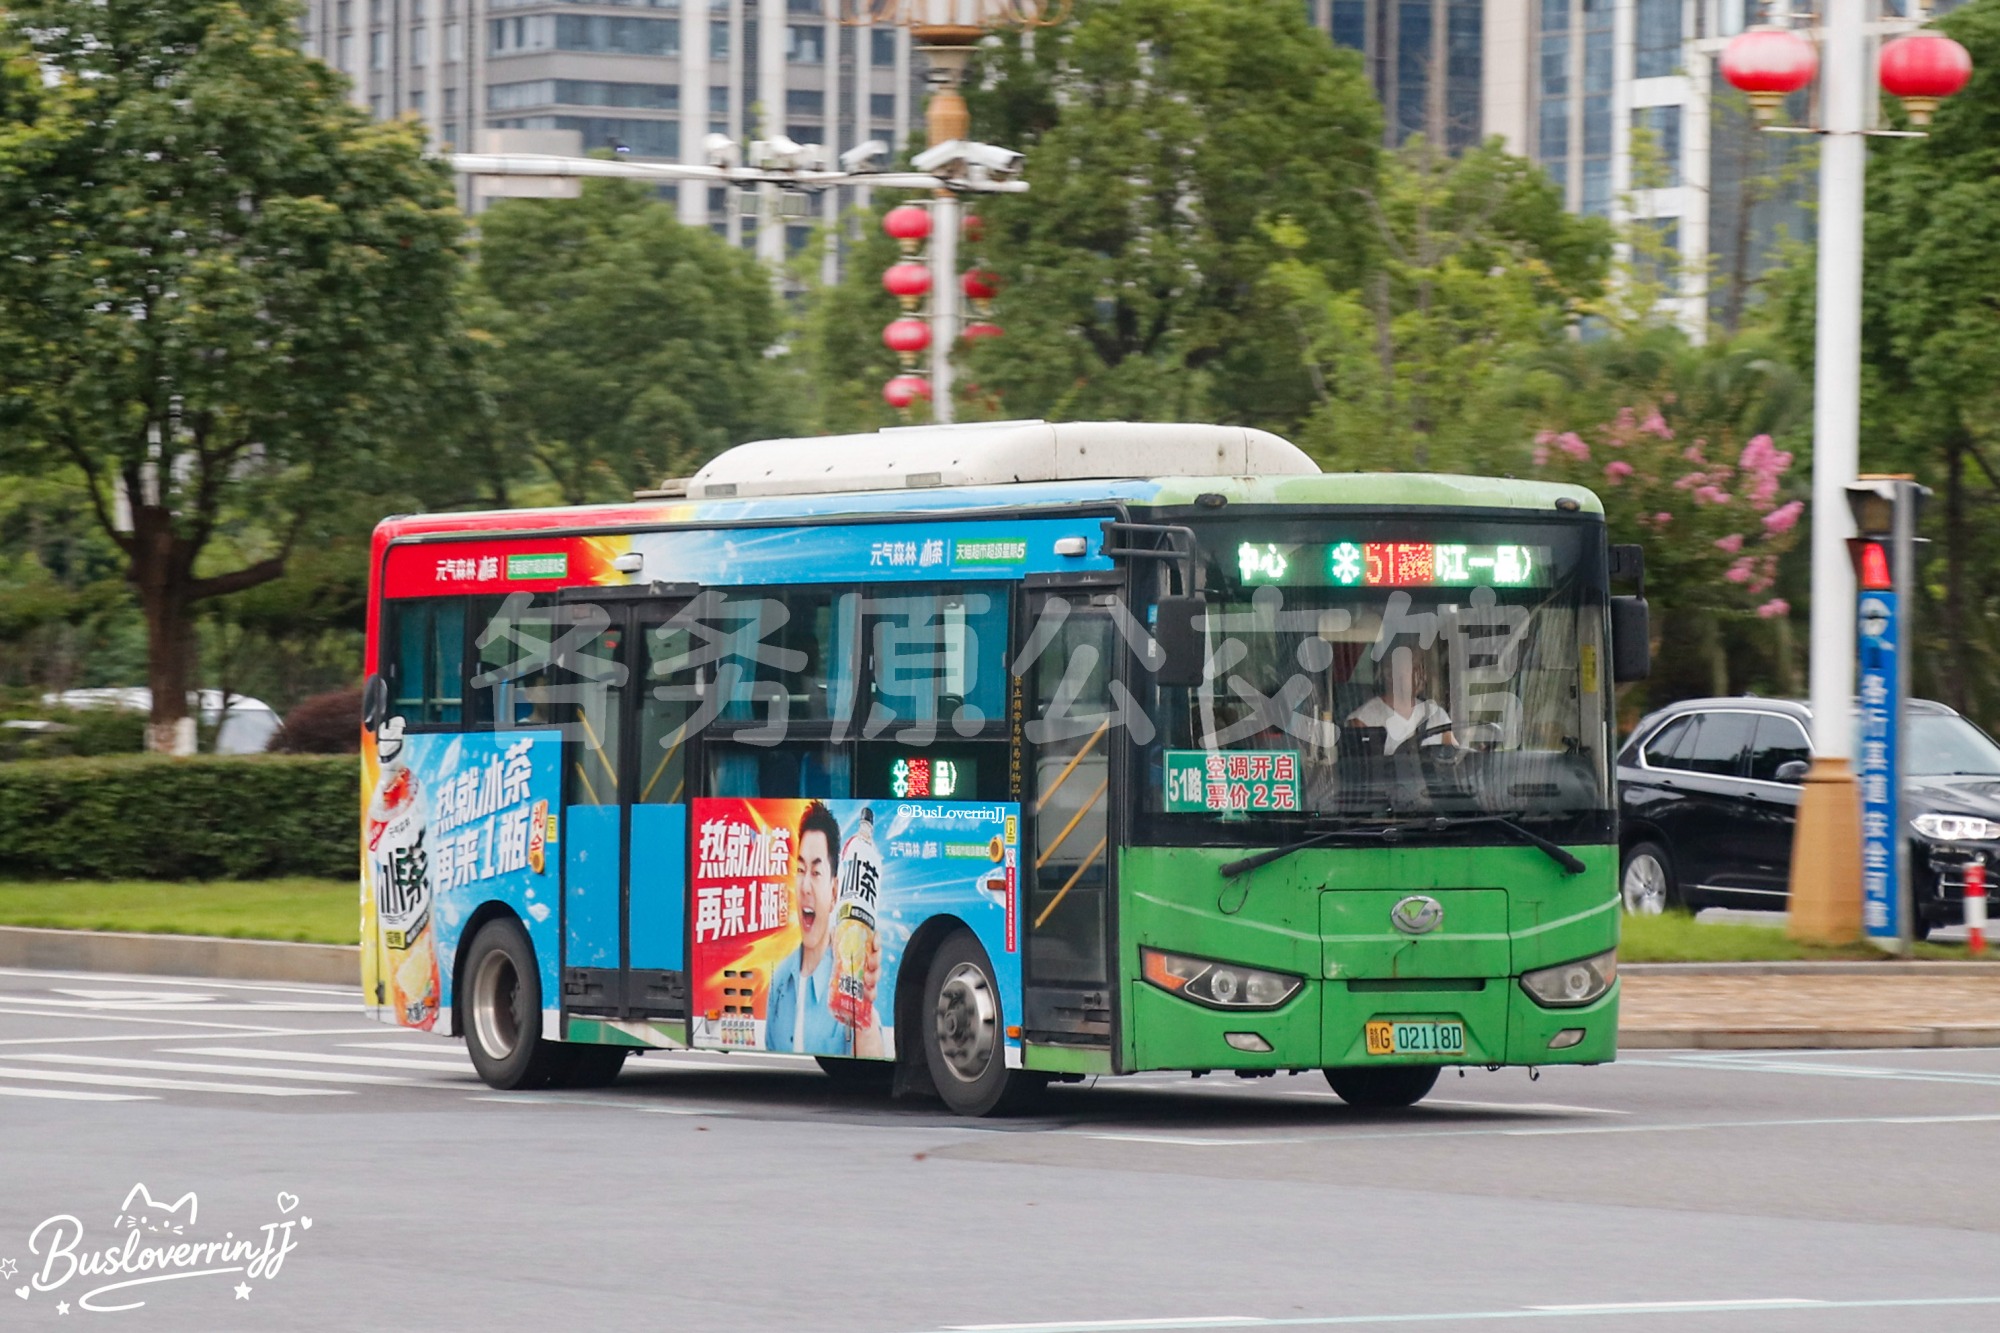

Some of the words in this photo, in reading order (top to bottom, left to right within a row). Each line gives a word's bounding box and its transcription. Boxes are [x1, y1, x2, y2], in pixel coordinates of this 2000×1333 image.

[870, 541, 917, 566] 元气森林
[435, 737, 535, 837] 热就冰茶
[1169, 767, 1202, 803] 51路
[1206, 755, 1294, 781] 空调开启
[1206, 784, 1295, 810] 票价2元
[432, 805, 531, 894] 再来1瓶
[697, 814, 790, 879] 热就冰茶
[696, 880, 780, 943] 再来1瓶
